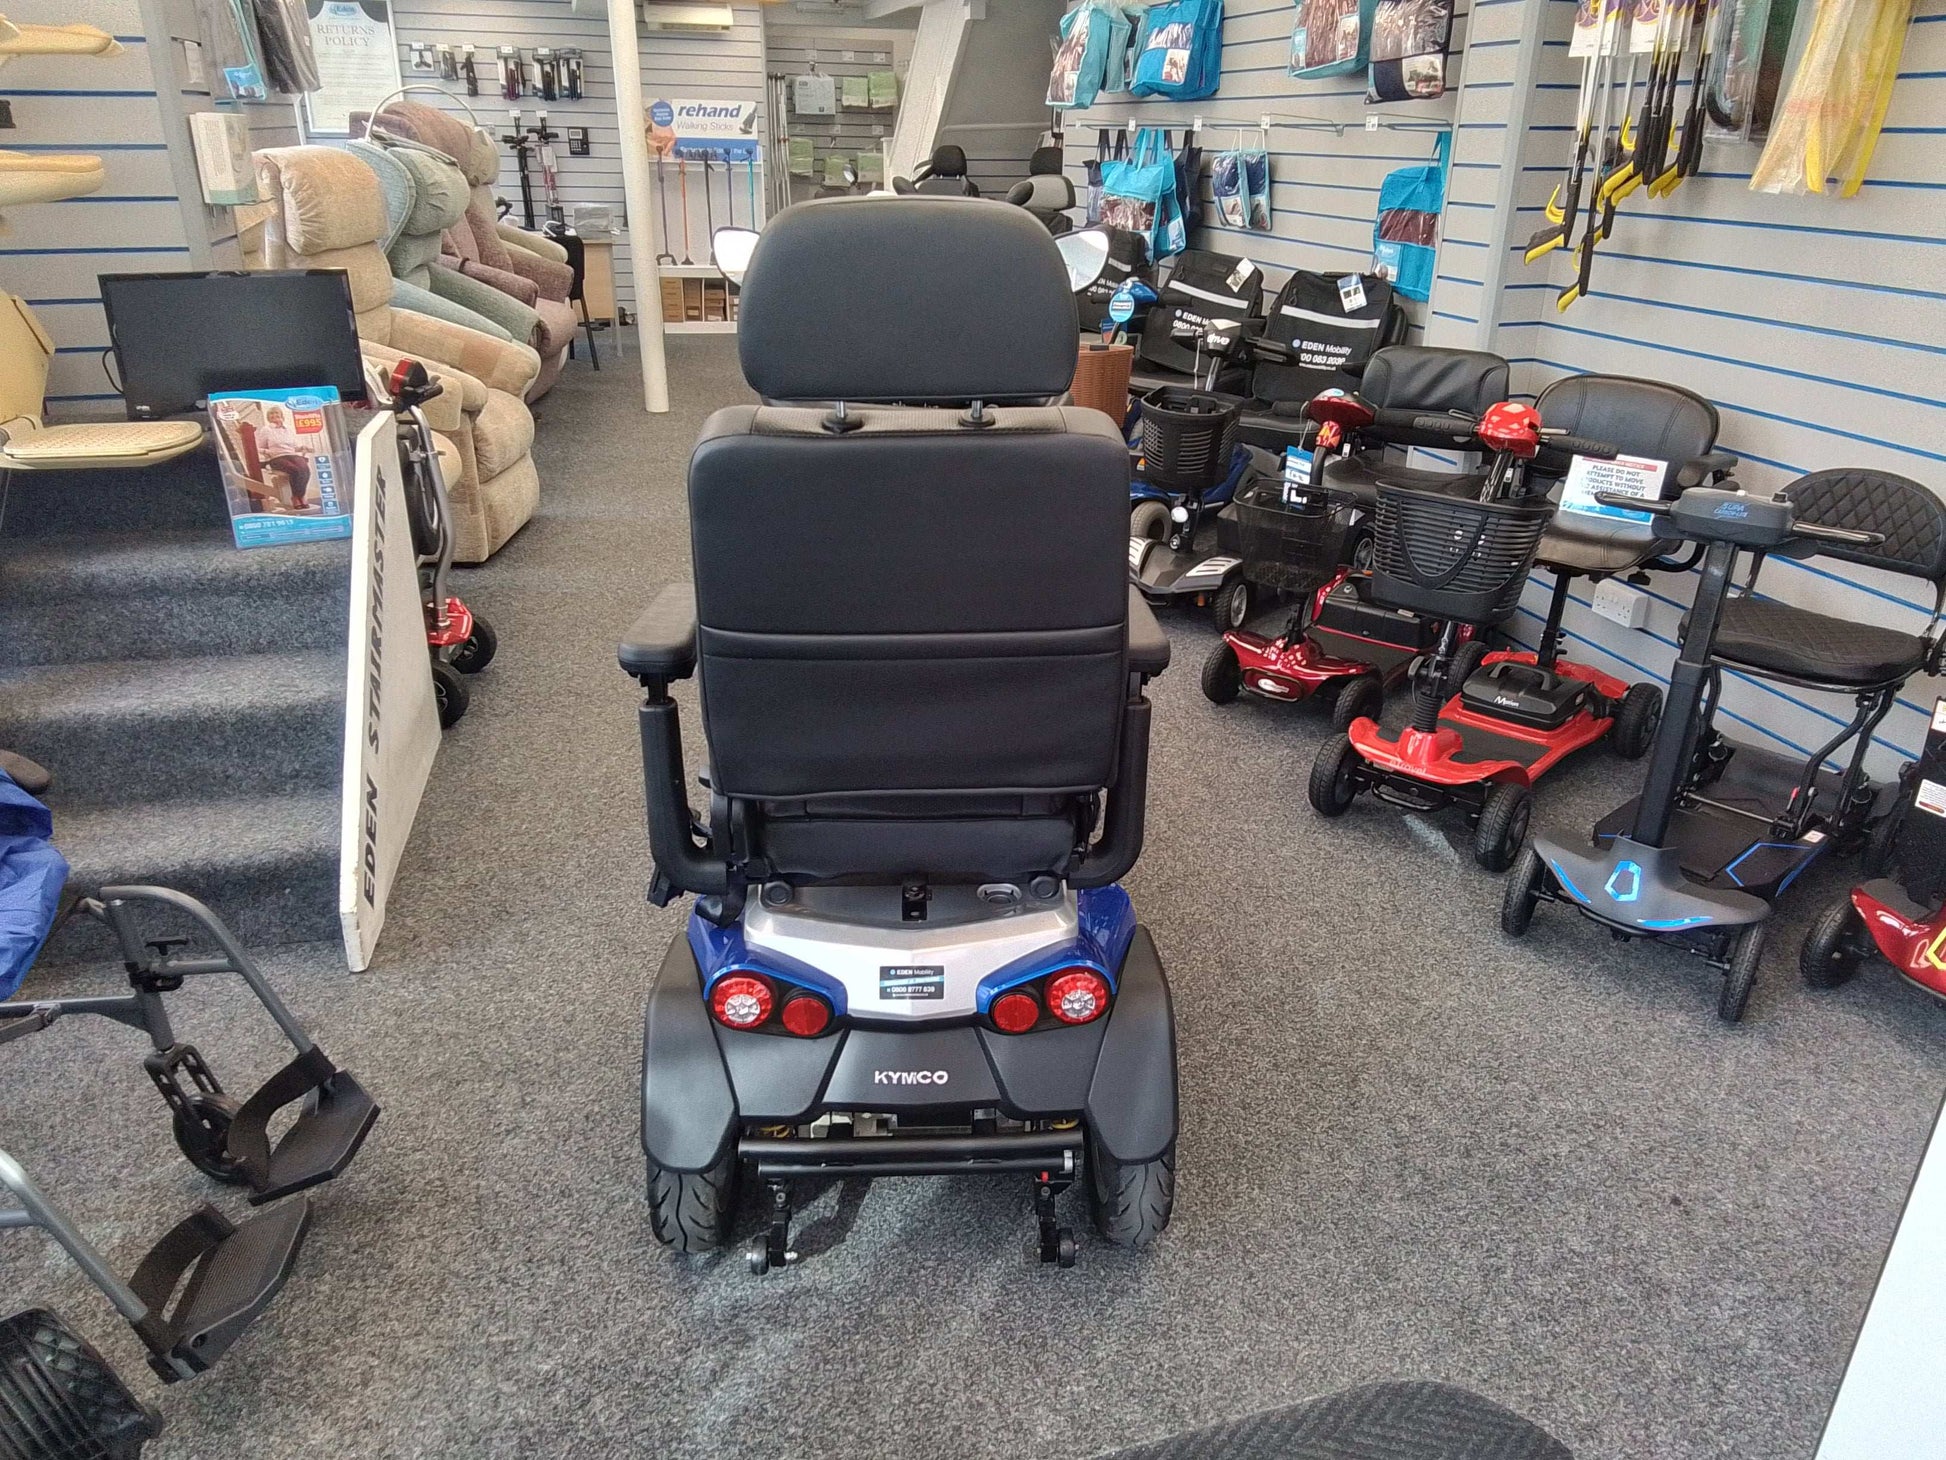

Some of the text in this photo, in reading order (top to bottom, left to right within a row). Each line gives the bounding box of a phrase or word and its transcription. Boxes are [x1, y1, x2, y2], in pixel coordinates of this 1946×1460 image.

[317, 23, 376, 36] RETURNS
[324, 35, 370, 47] POLICY
[678, 103, 742, 118] rehand
[677, 121, 733, 131] Walking Sticks
[1182, 311, 1203, 324] EDEN
[1302, 340, 1353, 356] EDEN Mobility
[1592, 465, 1615, 473] PLEASE
[1626, 469, 1641, 477] NOT
[1614, 482, 1646, 491] WITHOUT
[1625, 477, 1644, 485] MOVE
[1591, 484, 1629, 495] ASSISTANCE
[363, 464, 386, 911] EDEN STAIRMASTER
[913, 969, 935, 977] Mobility
[874, 1070, 949, 1085] KYMCO
